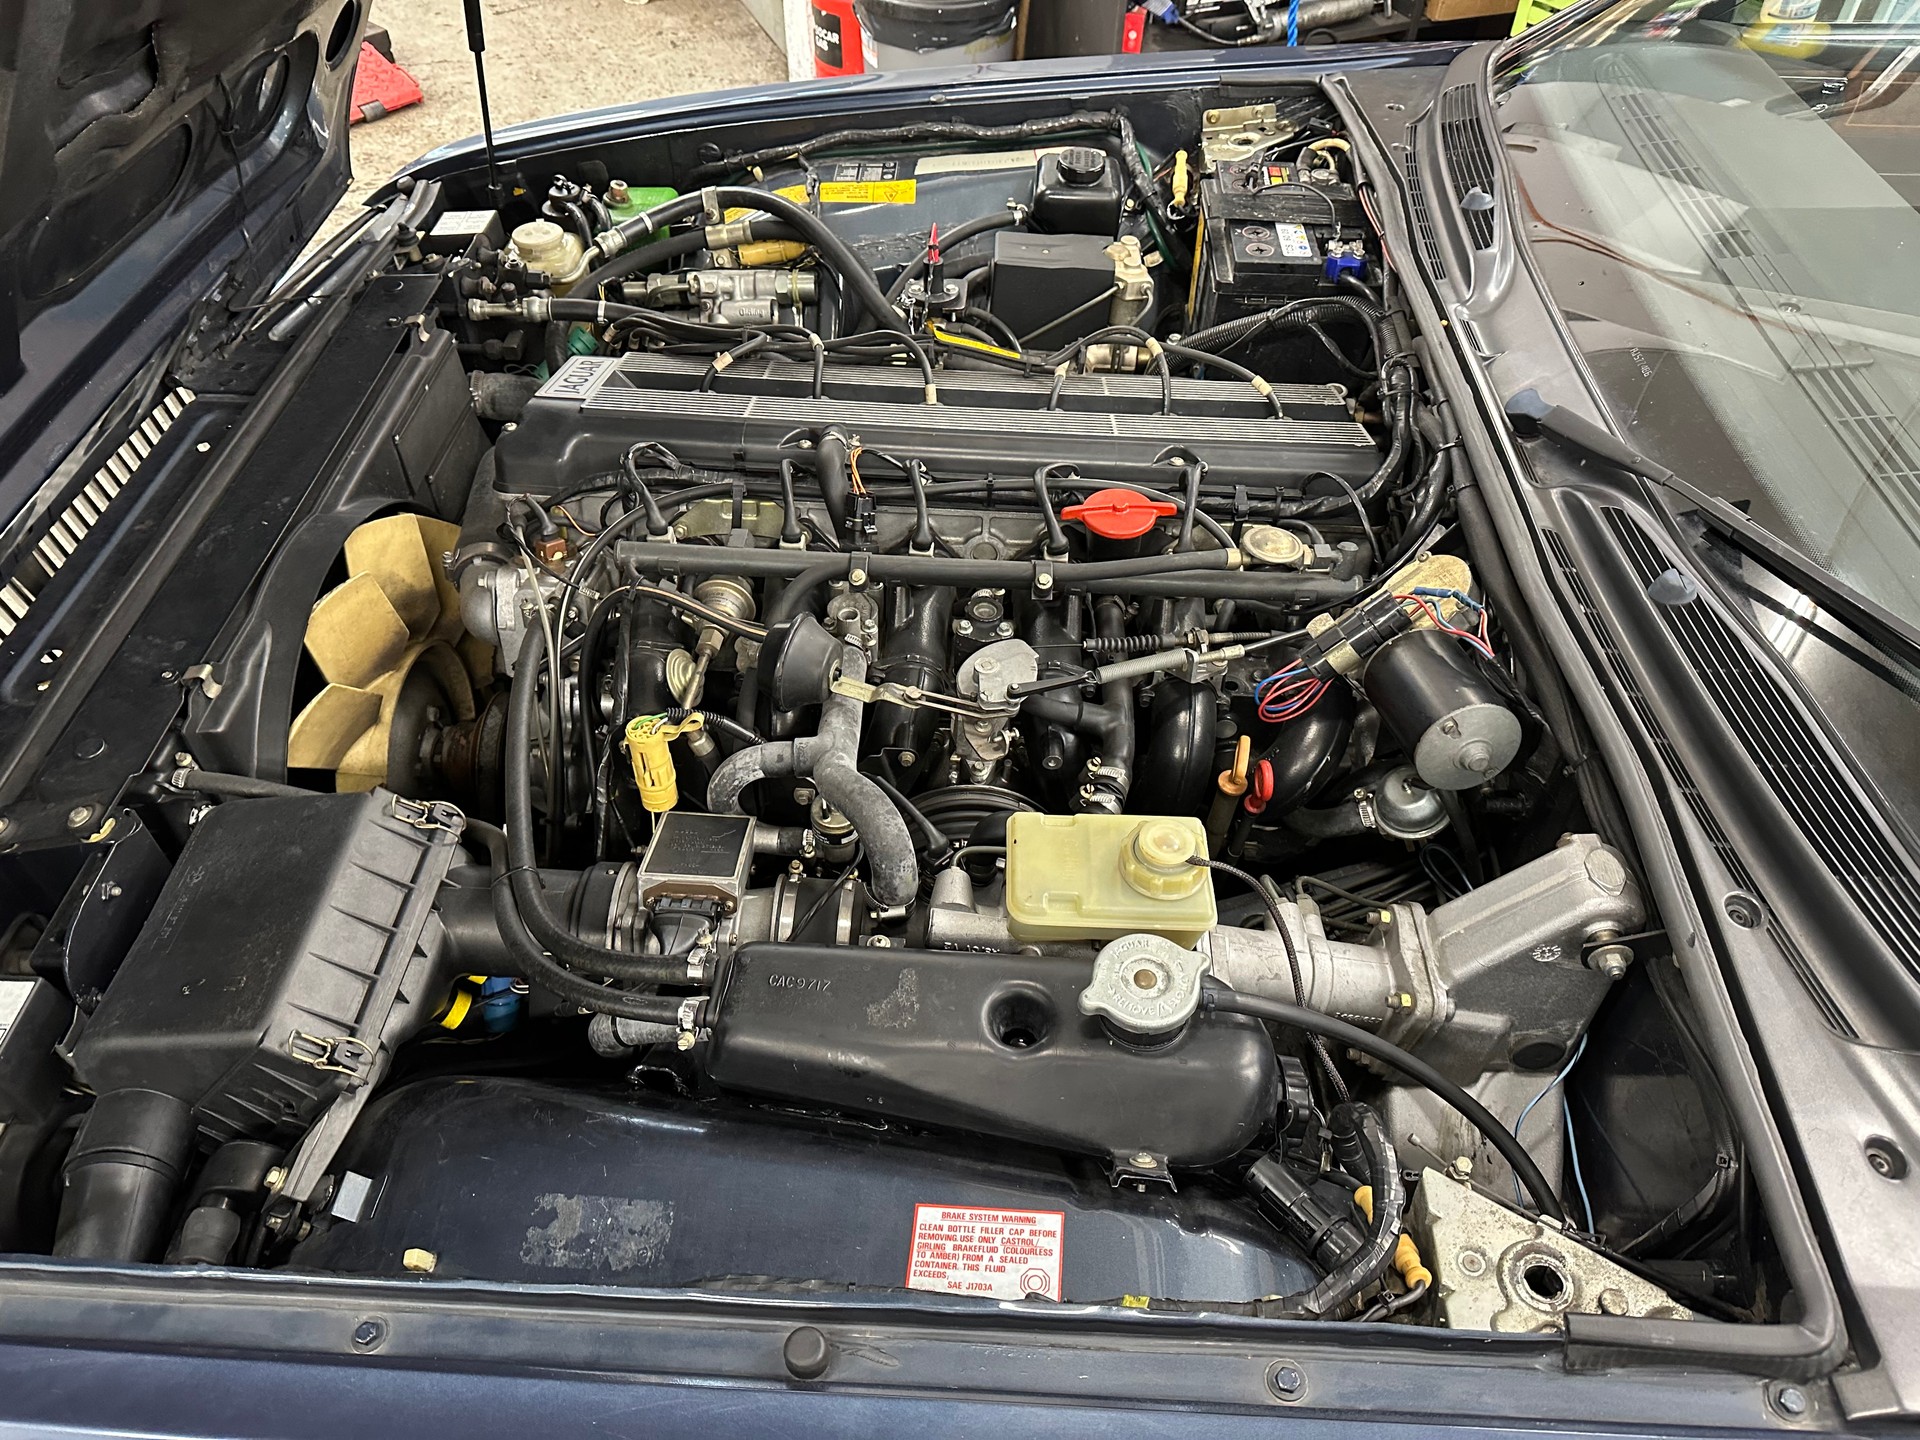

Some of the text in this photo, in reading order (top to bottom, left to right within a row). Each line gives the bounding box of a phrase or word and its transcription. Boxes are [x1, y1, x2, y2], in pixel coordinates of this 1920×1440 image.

[553, 360, 605, 394] JAGUAR
[1111, 939, 1149, 959] JAGUAR
[941, 1212, 1037, 1224] BRAKE SYSTEM WARNING
[919, 1223, 1057, 1238] CLEAN BOTTLE FILLER CAP BEFORE
[960, 1235, 974, 1243] USE
[978, 1236, 996, 1244] ONLY
[1001, 1237, 1040, 1247] CASTROL/
[917, 1242, 1053, 1256] GIRLING BRAKEFLUID (COLOURLESS
[930, 1252, 960, 1262] AMBER)
[962, 1254, 983, 1262] FROM
[988, 1255, 994, 1263] A
[999, 1255, 1028, 1264] SEALED
[962, 1263, 980, 1271] THIS
[984, 1264, 1006, 1273] FLUID
[947, 1281, 993, 1291] SAE J1703A
